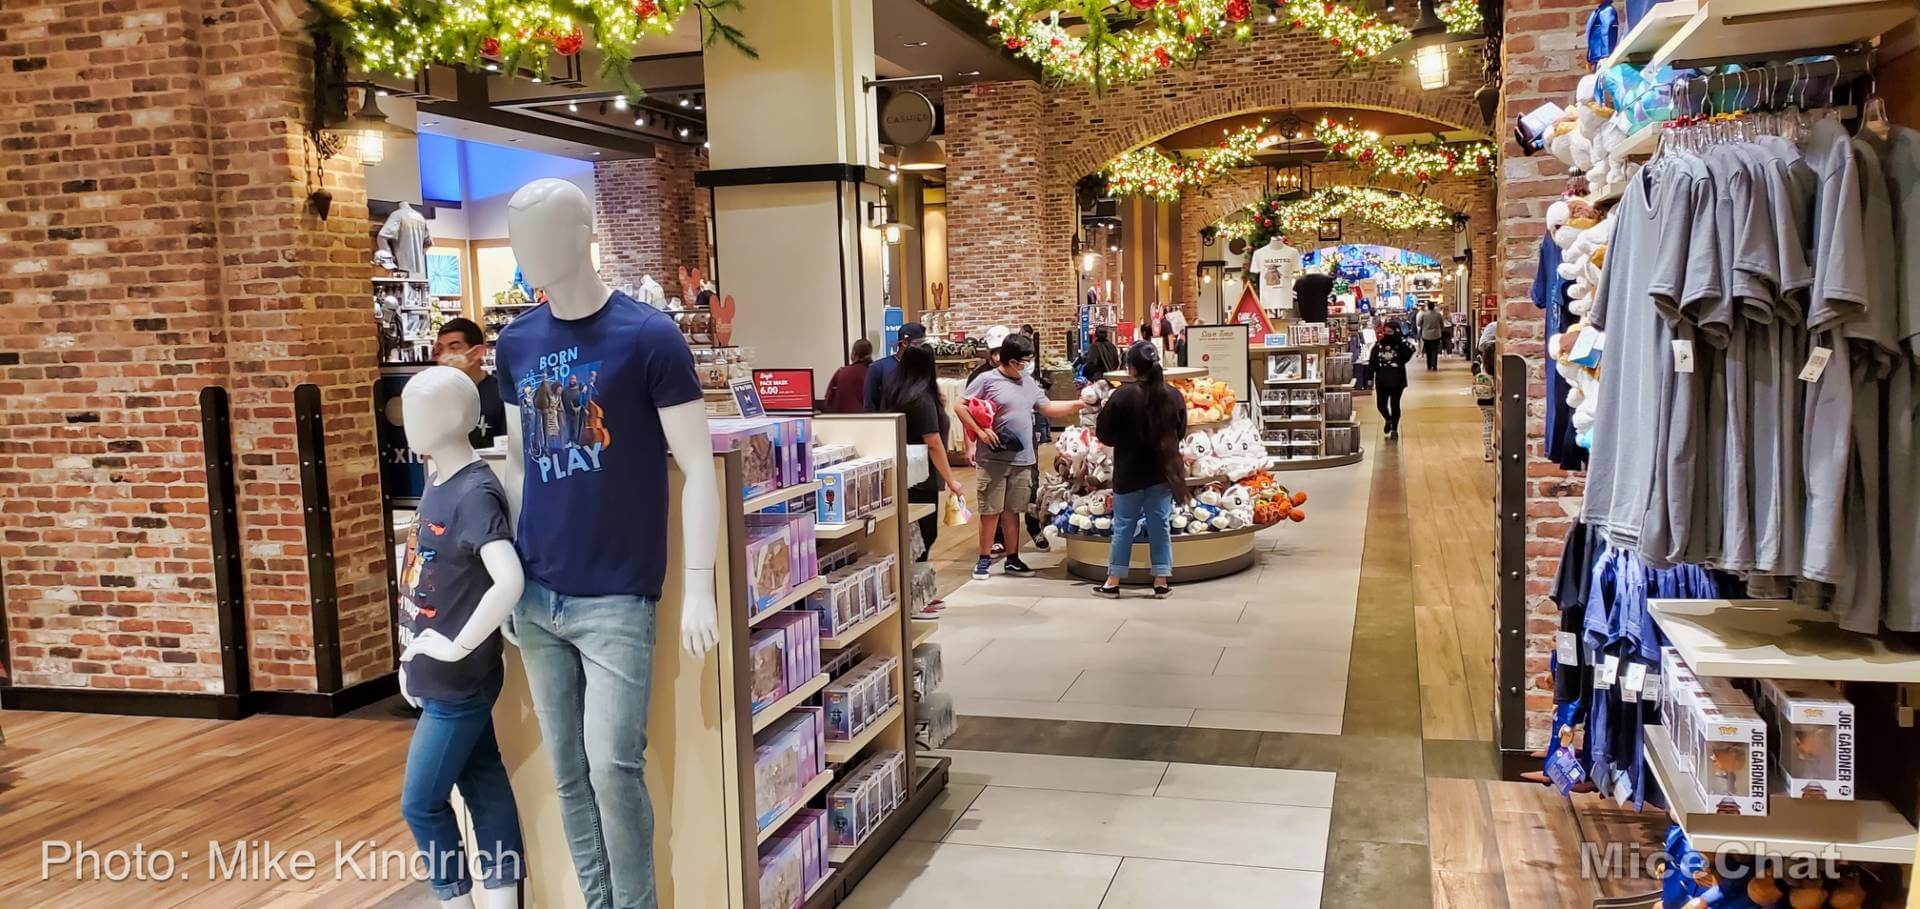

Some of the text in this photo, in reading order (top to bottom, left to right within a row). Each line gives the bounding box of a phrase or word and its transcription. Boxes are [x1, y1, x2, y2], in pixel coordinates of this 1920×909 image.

[539, 346, 578, 371] BORN
[551, 363, 571, 381] TO
[760, 386, 778, 394] 6.00
[538, 442, 603, 483] PLAY
[1838, 710, 1853, 731] JOE
[1751, 728, 1764, 748] JOE
[1838, 733, 1852, 782] GARDNER
[1751, 750, 1765, 798] GARDNER
